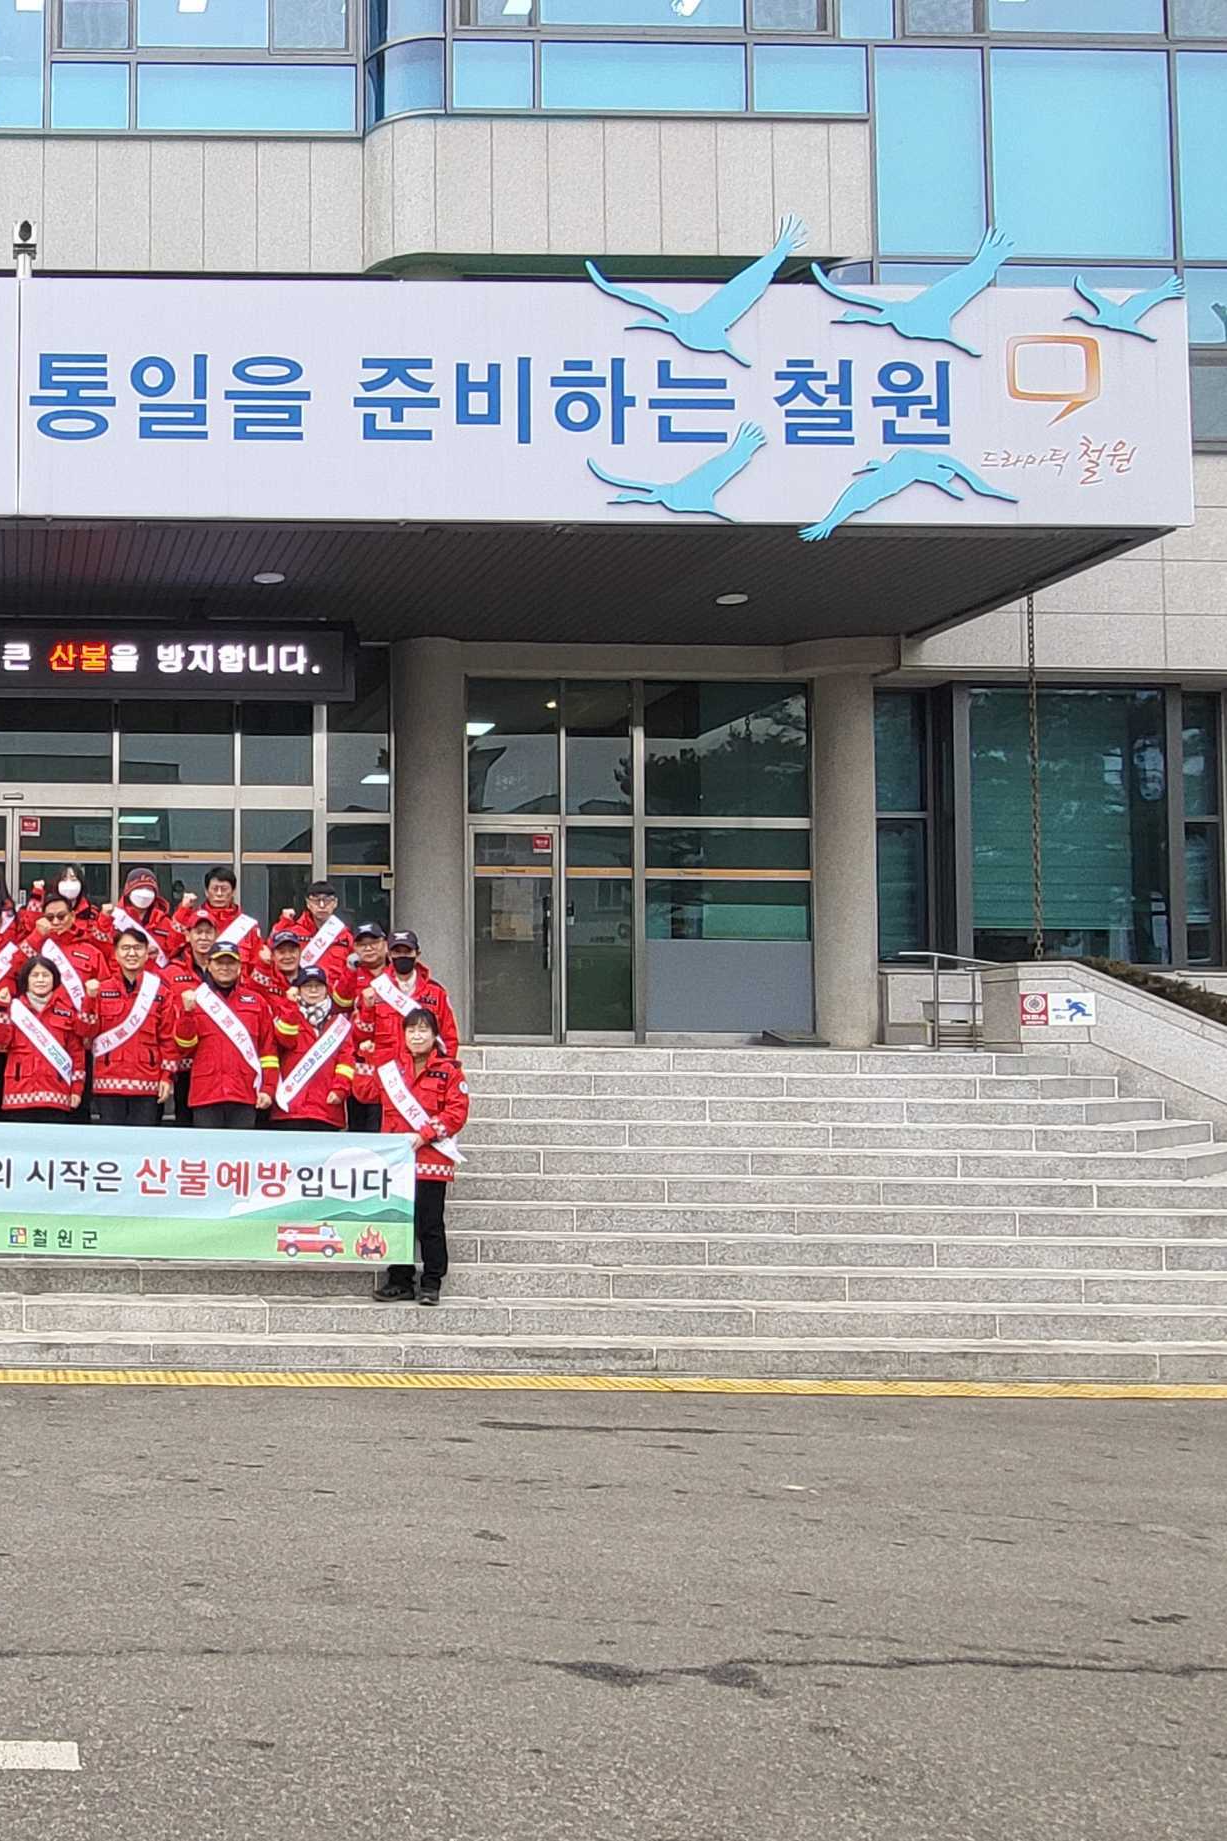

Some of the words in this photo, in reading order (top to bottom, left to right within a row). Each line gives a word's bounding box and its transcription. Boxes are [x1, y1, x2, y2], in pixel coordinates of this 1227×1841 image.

[29, 353, 311, 441] 통일을
[353, 356, 736, 444] 준비하는
[774, 358, 951, 446] 철원
[981, 448, 1070, 476] 드라마틱
[1078, 435, 1138, 485] 철원
[1, 642, 32, 671] 큰
[49, 641, 140, 673] 산불을
[156, 643, 321, 675] 방지합니다.
[27, 1160, 123, 1193] 시작은
